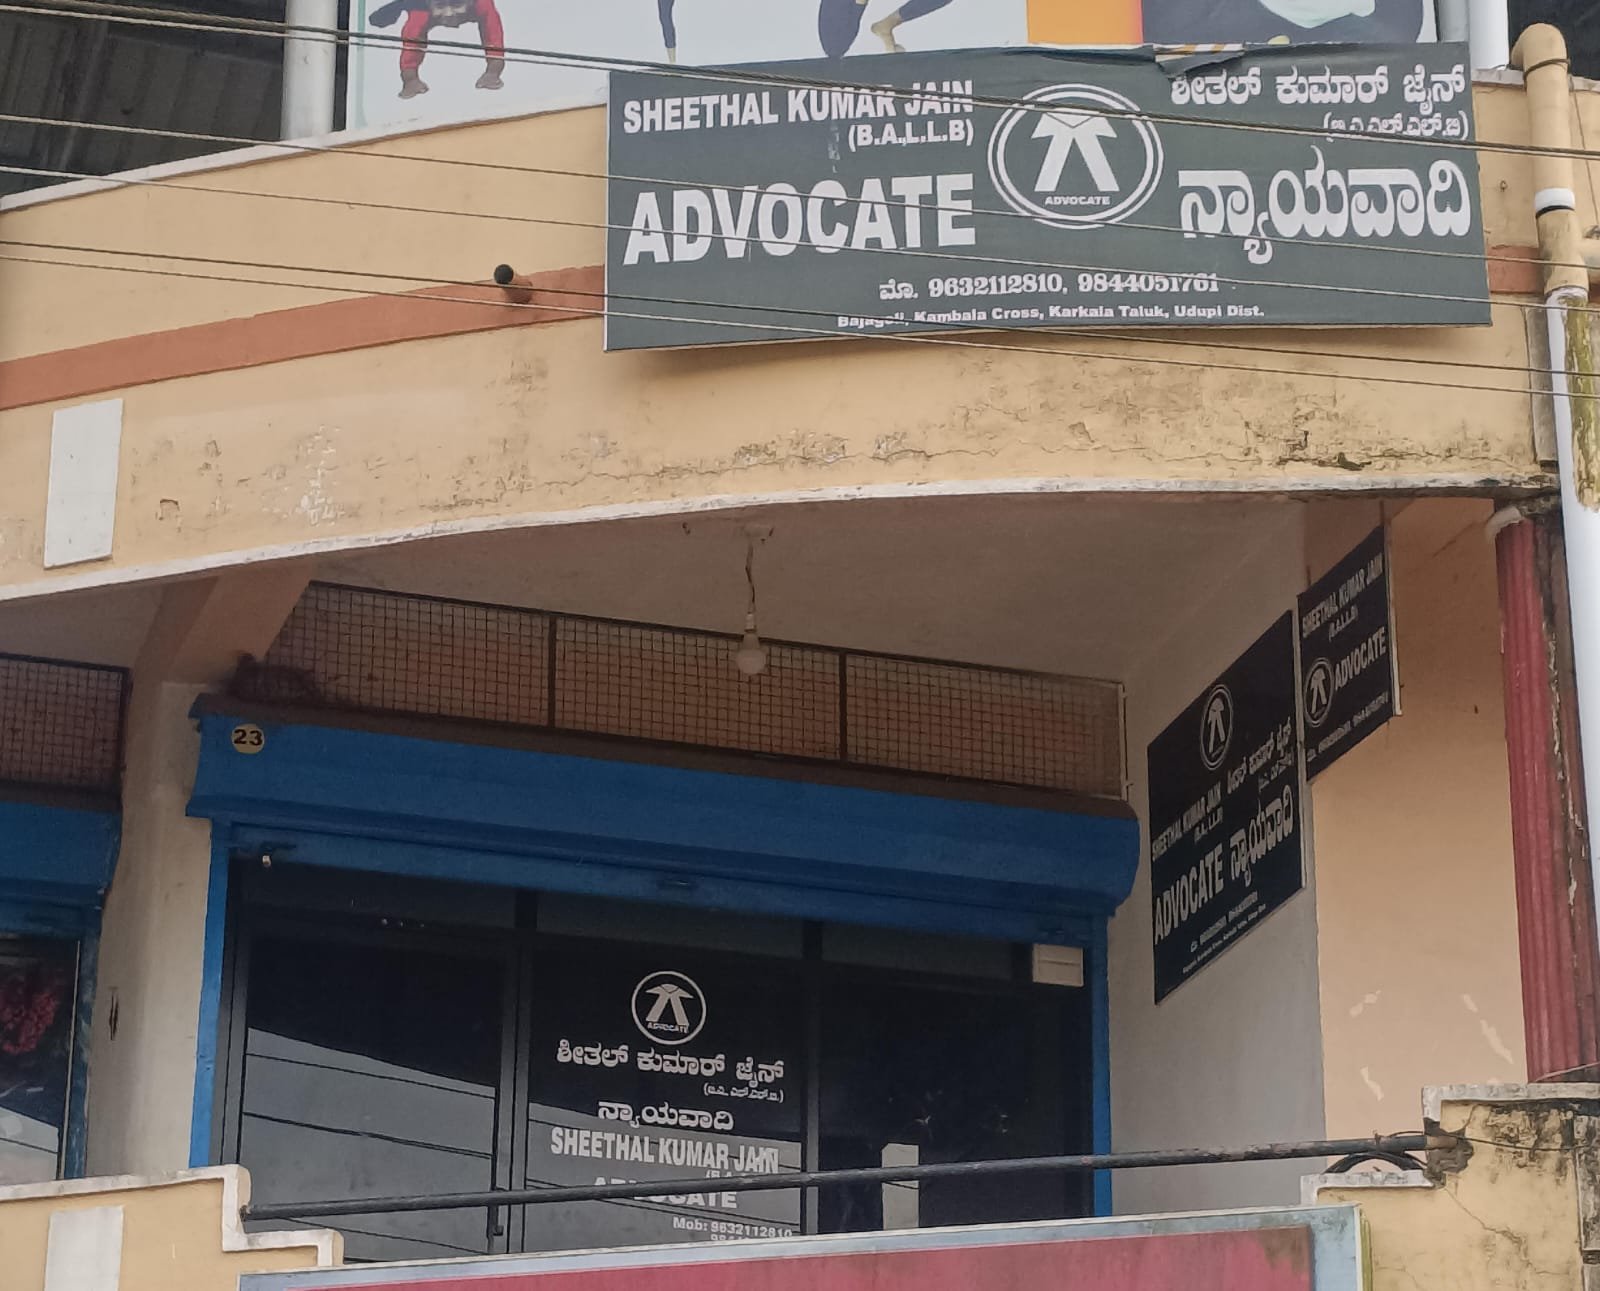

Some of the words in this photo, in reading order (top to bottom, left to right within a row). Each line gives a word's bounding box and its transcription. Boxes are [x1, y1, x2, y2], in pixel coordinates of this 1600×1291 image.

[624, 92, 779, 133] SHEETHAL
[788, 85, 896, 122] KUMAR
[905, 80, 973, 116] JAIN
[1171, 66, 1261, 105] ಶೀತಲ್
[1275, 64, 1388, 104] ಕುಮಾರ್
[1403, 64, 1466, 115] ಜೈನ್
[623, 173, 976, 265] ADVOCATE
[1045, 196, 1111, 205] ADVOCATE
[1178, 145, 1471, 264] ನ್ಯಾಯವಾದಿ
[928, 273, 1068, 297] 9632112810,
[1078, 273, 1219, 292] 9844051761
[914, 308, 986, 323] Kambala
[991, 307, 1044, 320] Cross,
[1049, 306, 1114, 318] Karkala
[1118, 306, 1170, 319] Taluk,
[1174, 306, 1222, 319] Udupi
[1227, 305, 1265, 317] Dist.
[1334, 626, 1387, 691] ADVOCATE
[234, 729, 263, 746] 23
[1154, 842, 1225, 946] ADVOCATE
[556, 1039, 629, 1068] ಶೀತಲ್
[637, 1047, 725, 1077] ಕುಮಾರ್
[735, 1056, 785, 1088] ಜೈನ್
[598, 1101, 734, 1131] ನ್ಯಾಯವಾದಿ
[550, 1127, 654, 1163] SHEETHAL
[659, 1138, 729, 1170] KUMAR
[733, 1144, 779, 1174] JAIN
[673, 1216, 708, 1231] Mob:
[711, 1221, 793, 1238] 9632112810
